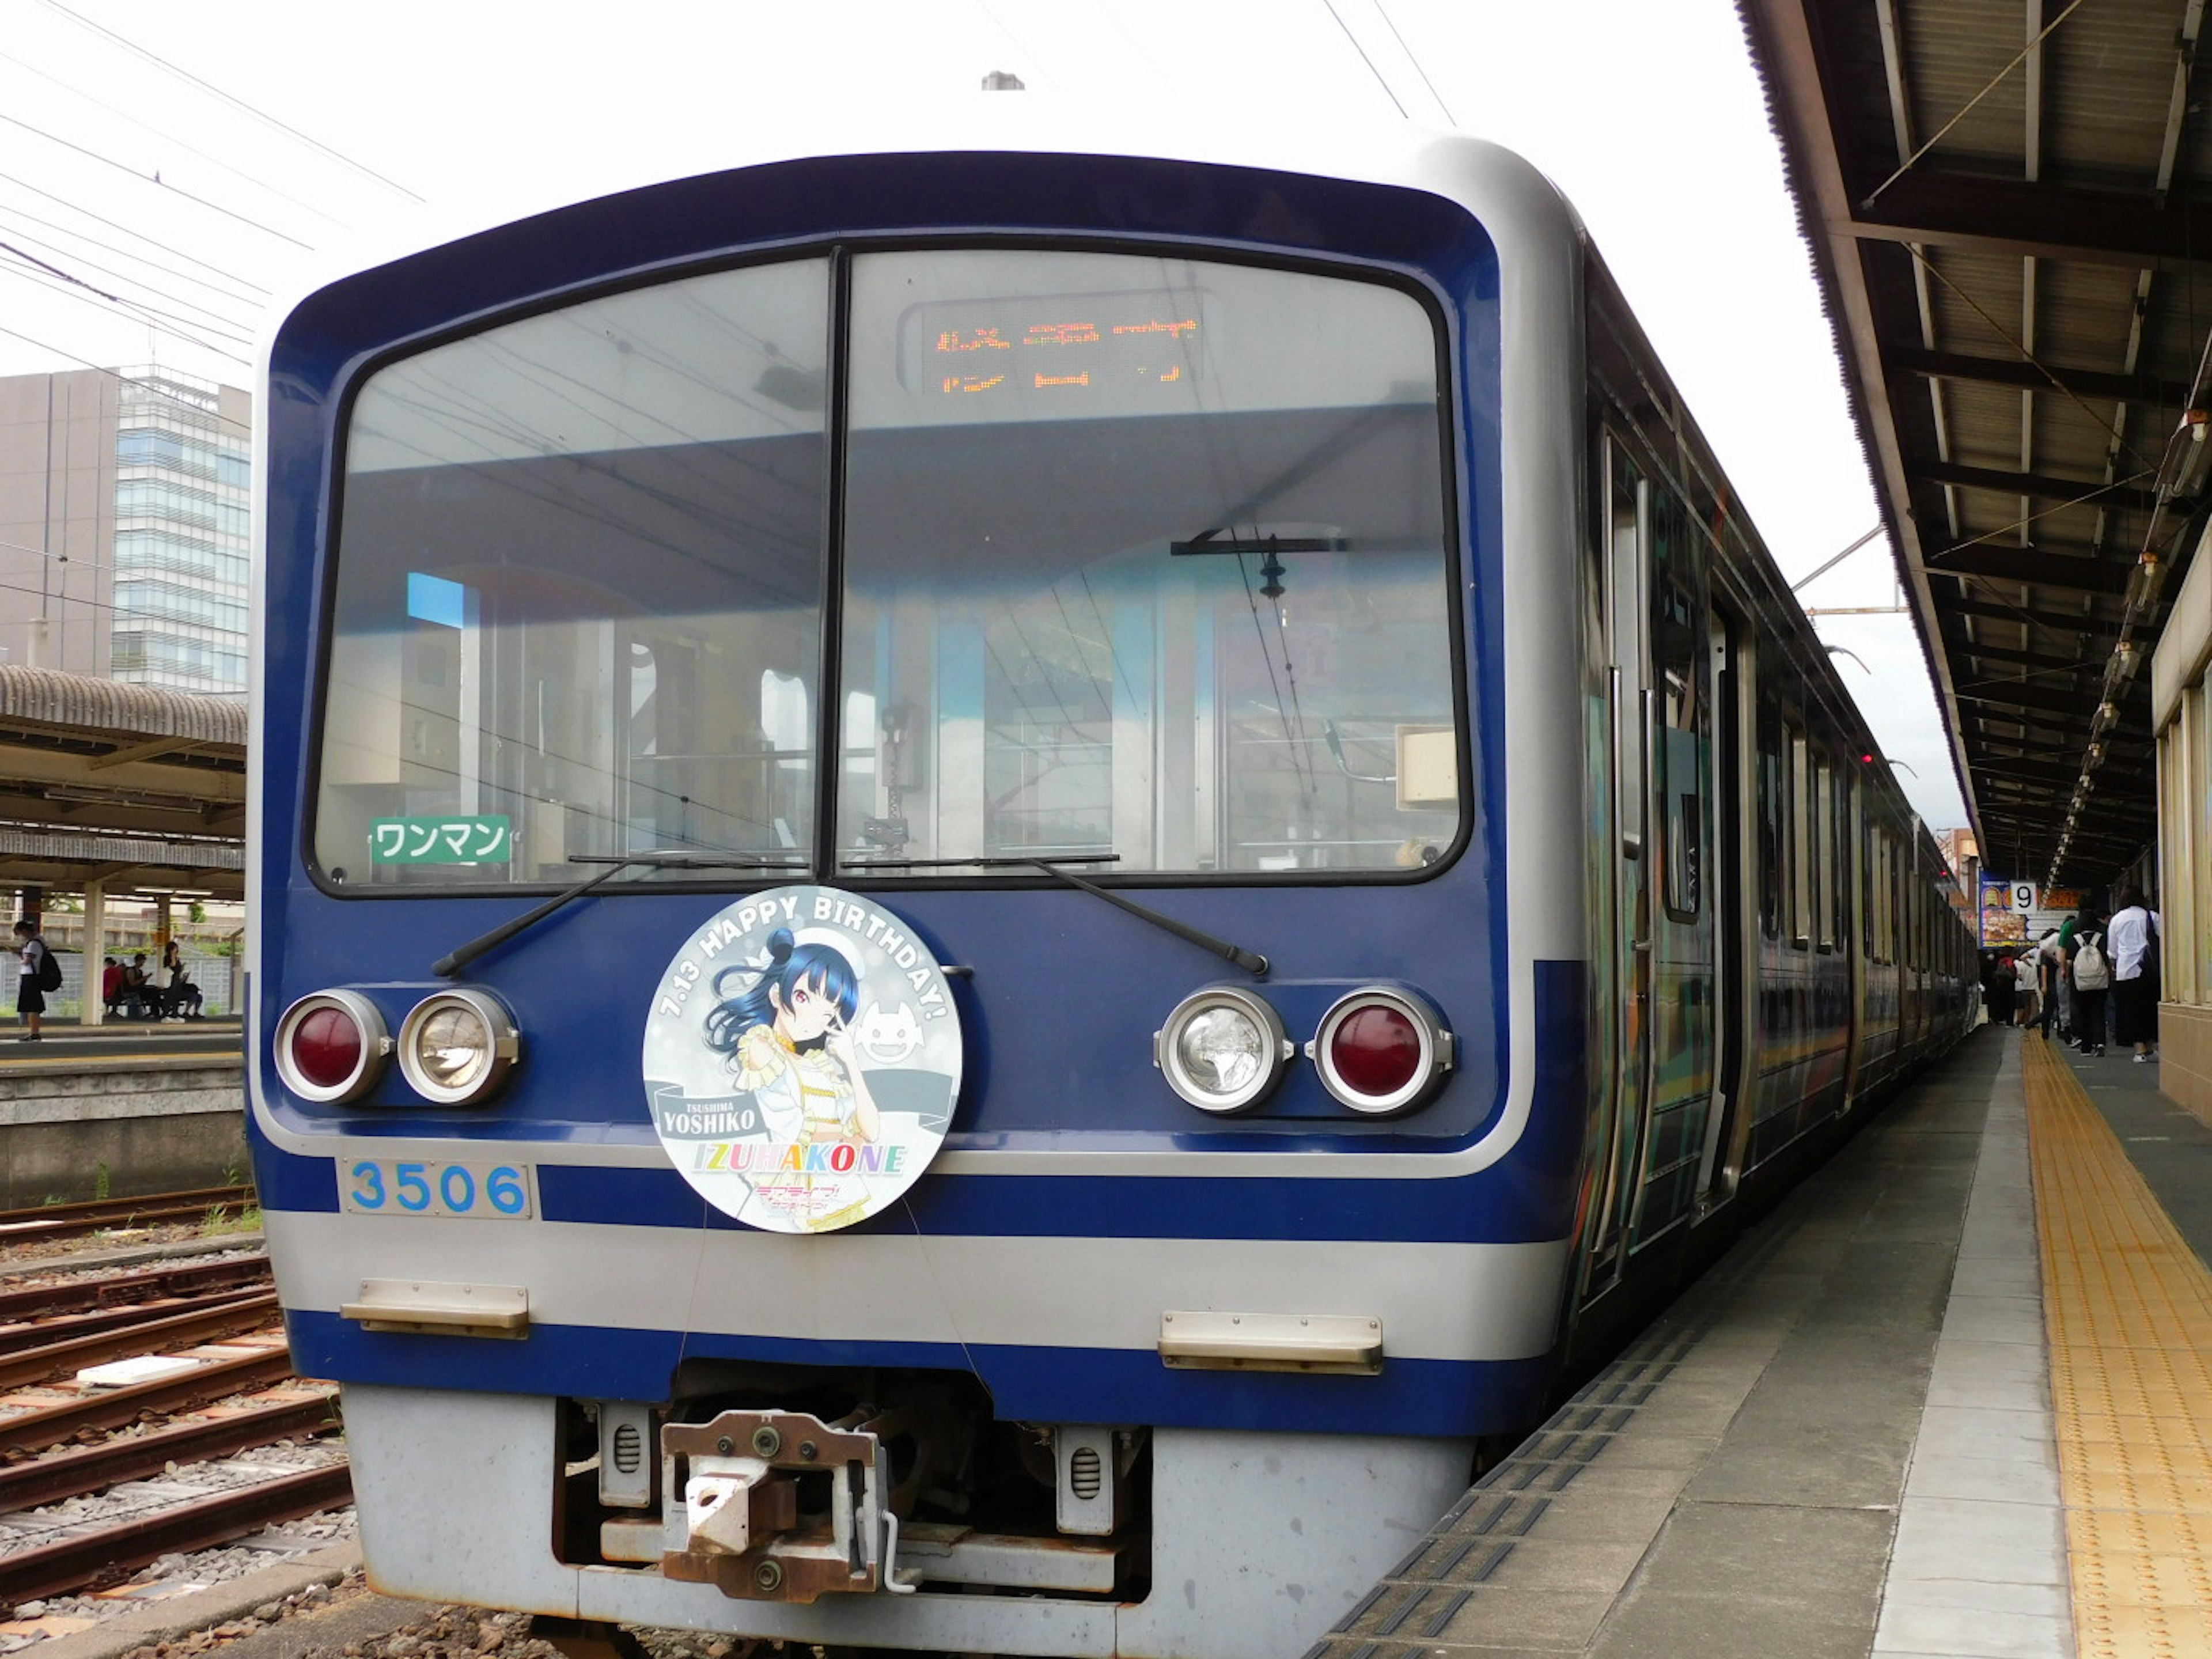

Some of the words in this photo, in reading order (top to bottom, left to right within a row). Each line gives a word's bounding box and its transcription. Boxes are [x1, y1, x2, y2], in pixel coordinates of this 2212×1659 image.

[377, 823, 504, 857] ワンマン
[2017, 886, 2031, 908] 9
[659, 961, 701, 1019] 7.13
[698, 895, 799, 960] HAPPY
[813, 896, 949, 1021] BIRTHDAY!
[664, 1109, 755, 1135] YOSHIKO
[693, 1143, 907, 1173] IZUHAKONE
[352, 1161, 524, 1214] 3506
